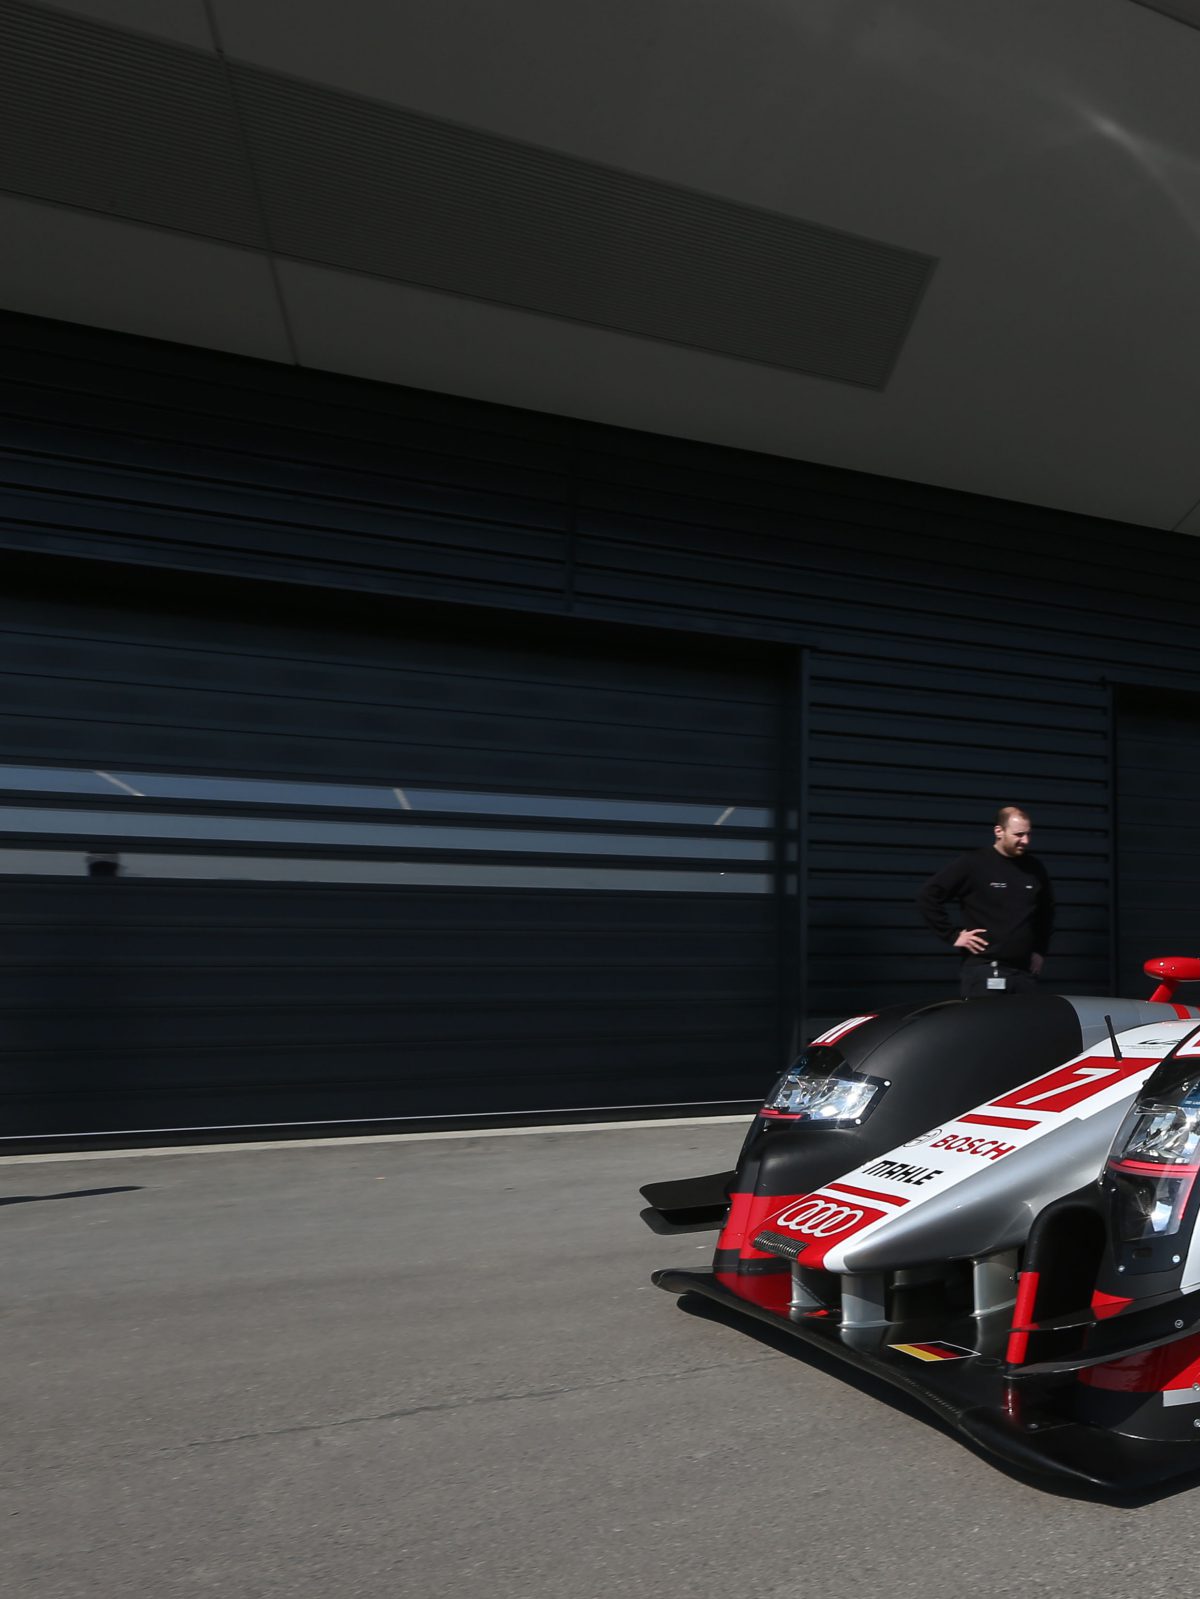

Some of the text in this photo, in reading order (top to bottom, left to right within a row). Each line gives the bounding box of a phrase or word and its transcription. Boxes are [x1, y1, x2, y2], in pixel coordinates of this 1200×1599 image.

[1015, 1067, 1121, 1105] 7
[929, 1134, 1017, 1161] BOSCH
[862, 1160, 944, 1186] MAHLE
